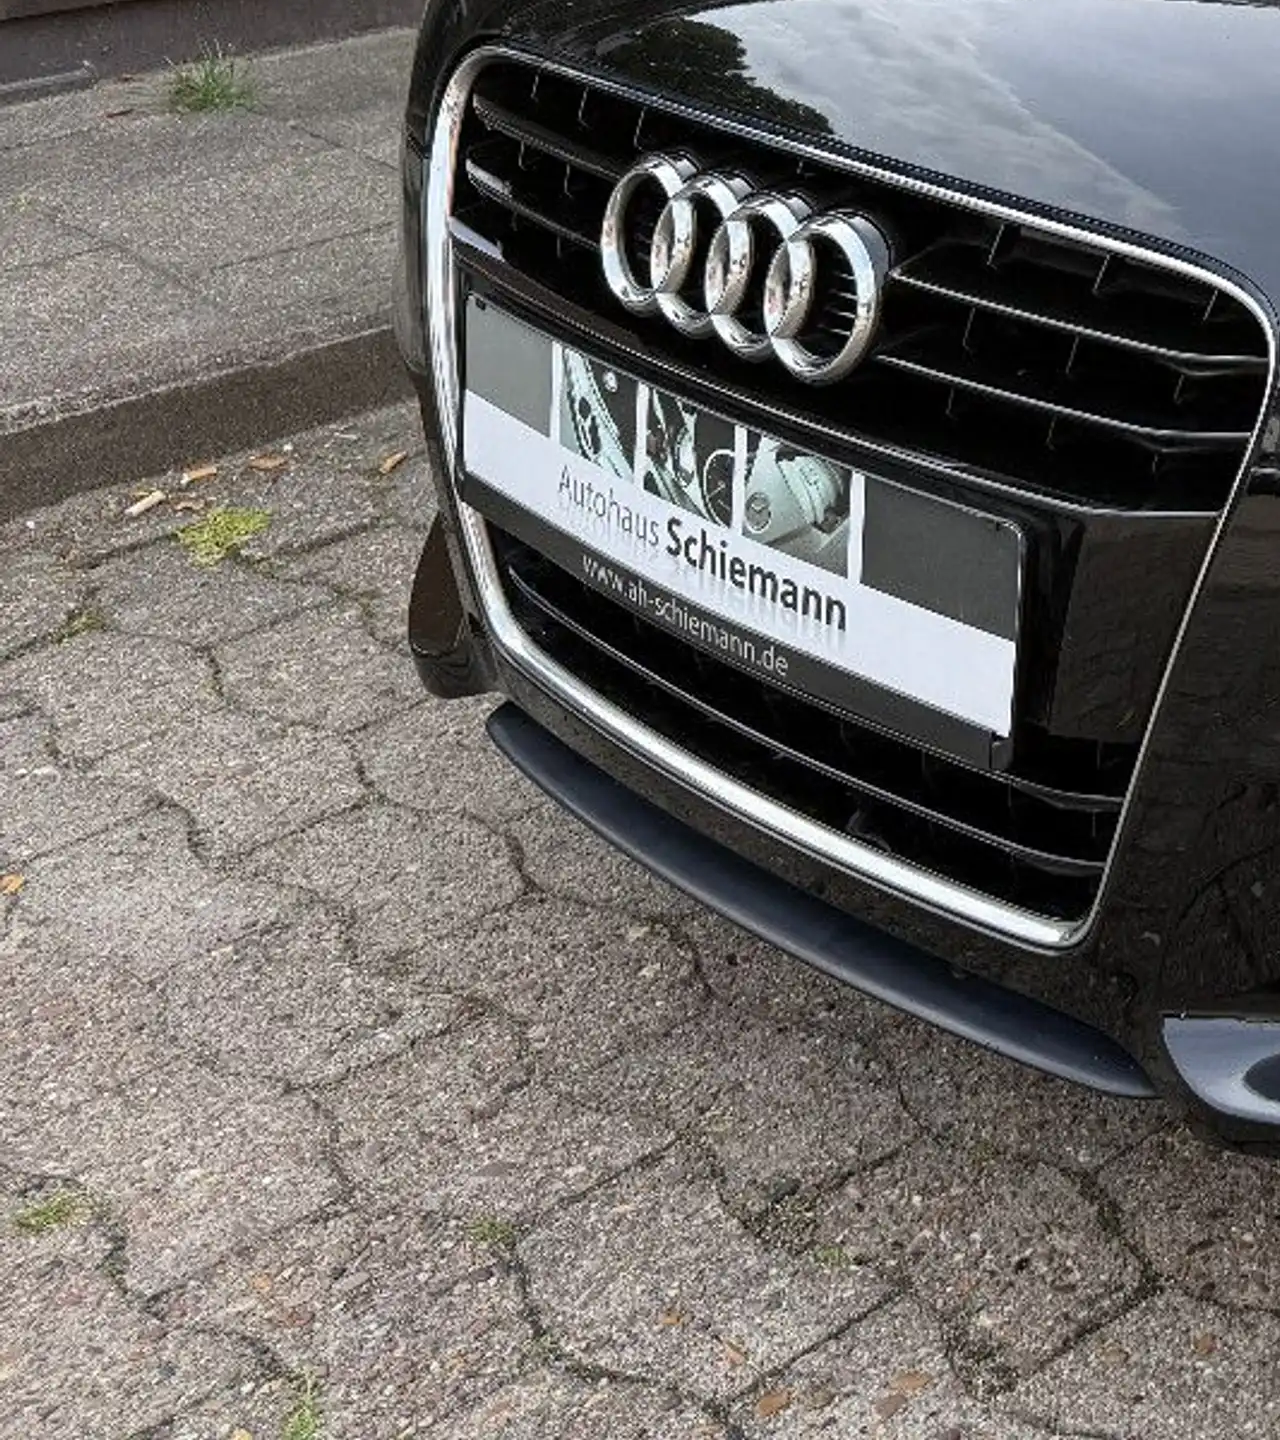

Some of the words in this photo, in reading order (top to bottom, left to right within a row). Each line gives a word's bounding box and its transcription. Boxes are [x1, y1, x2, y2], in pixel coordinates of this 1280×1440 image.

[558, 464, 660, 547] Autohaus
[666, 516, 847, 632] Schiemann
[582, 554, 789, 678] www.ah-schiemann.de
